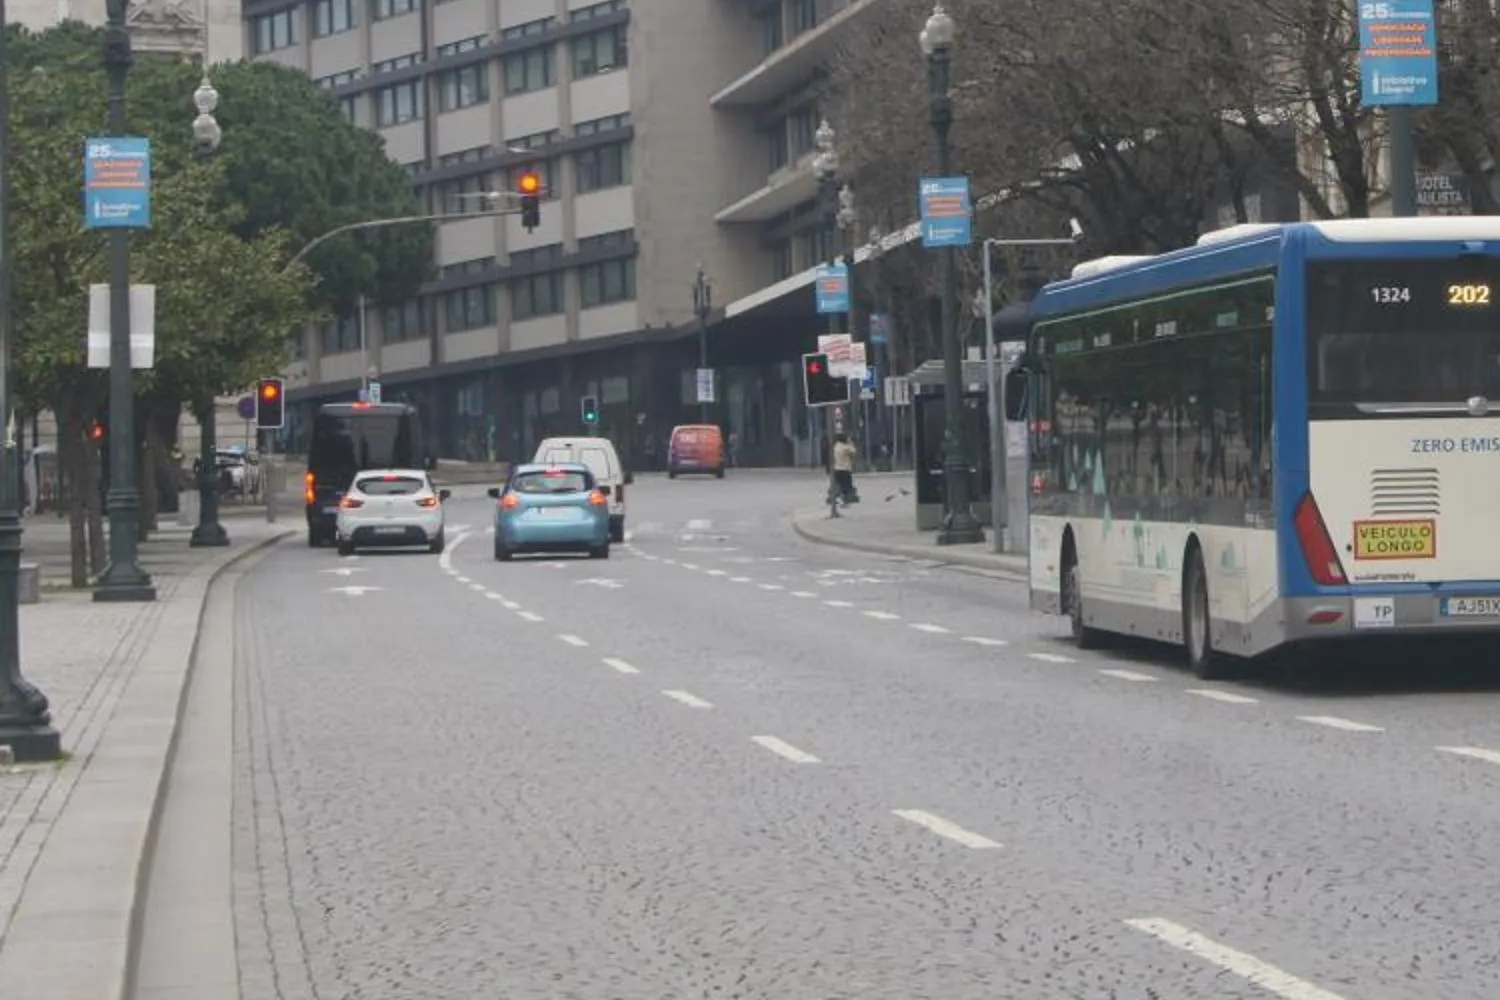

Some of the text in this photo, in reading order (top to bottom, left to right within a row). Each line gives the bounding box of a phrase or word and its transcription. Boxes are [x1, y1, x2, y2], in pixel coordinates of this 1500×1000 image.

[1361, 3, 1389, 19] 25
[1371, 287, 1411, 303] 1324
[1448, 284, 1490, 304] 202
[1411, 438, 1455, 453] ZERO
[1367, 540, 1426, 553] LONGO
[1374, 605, 1392, 618] TP
